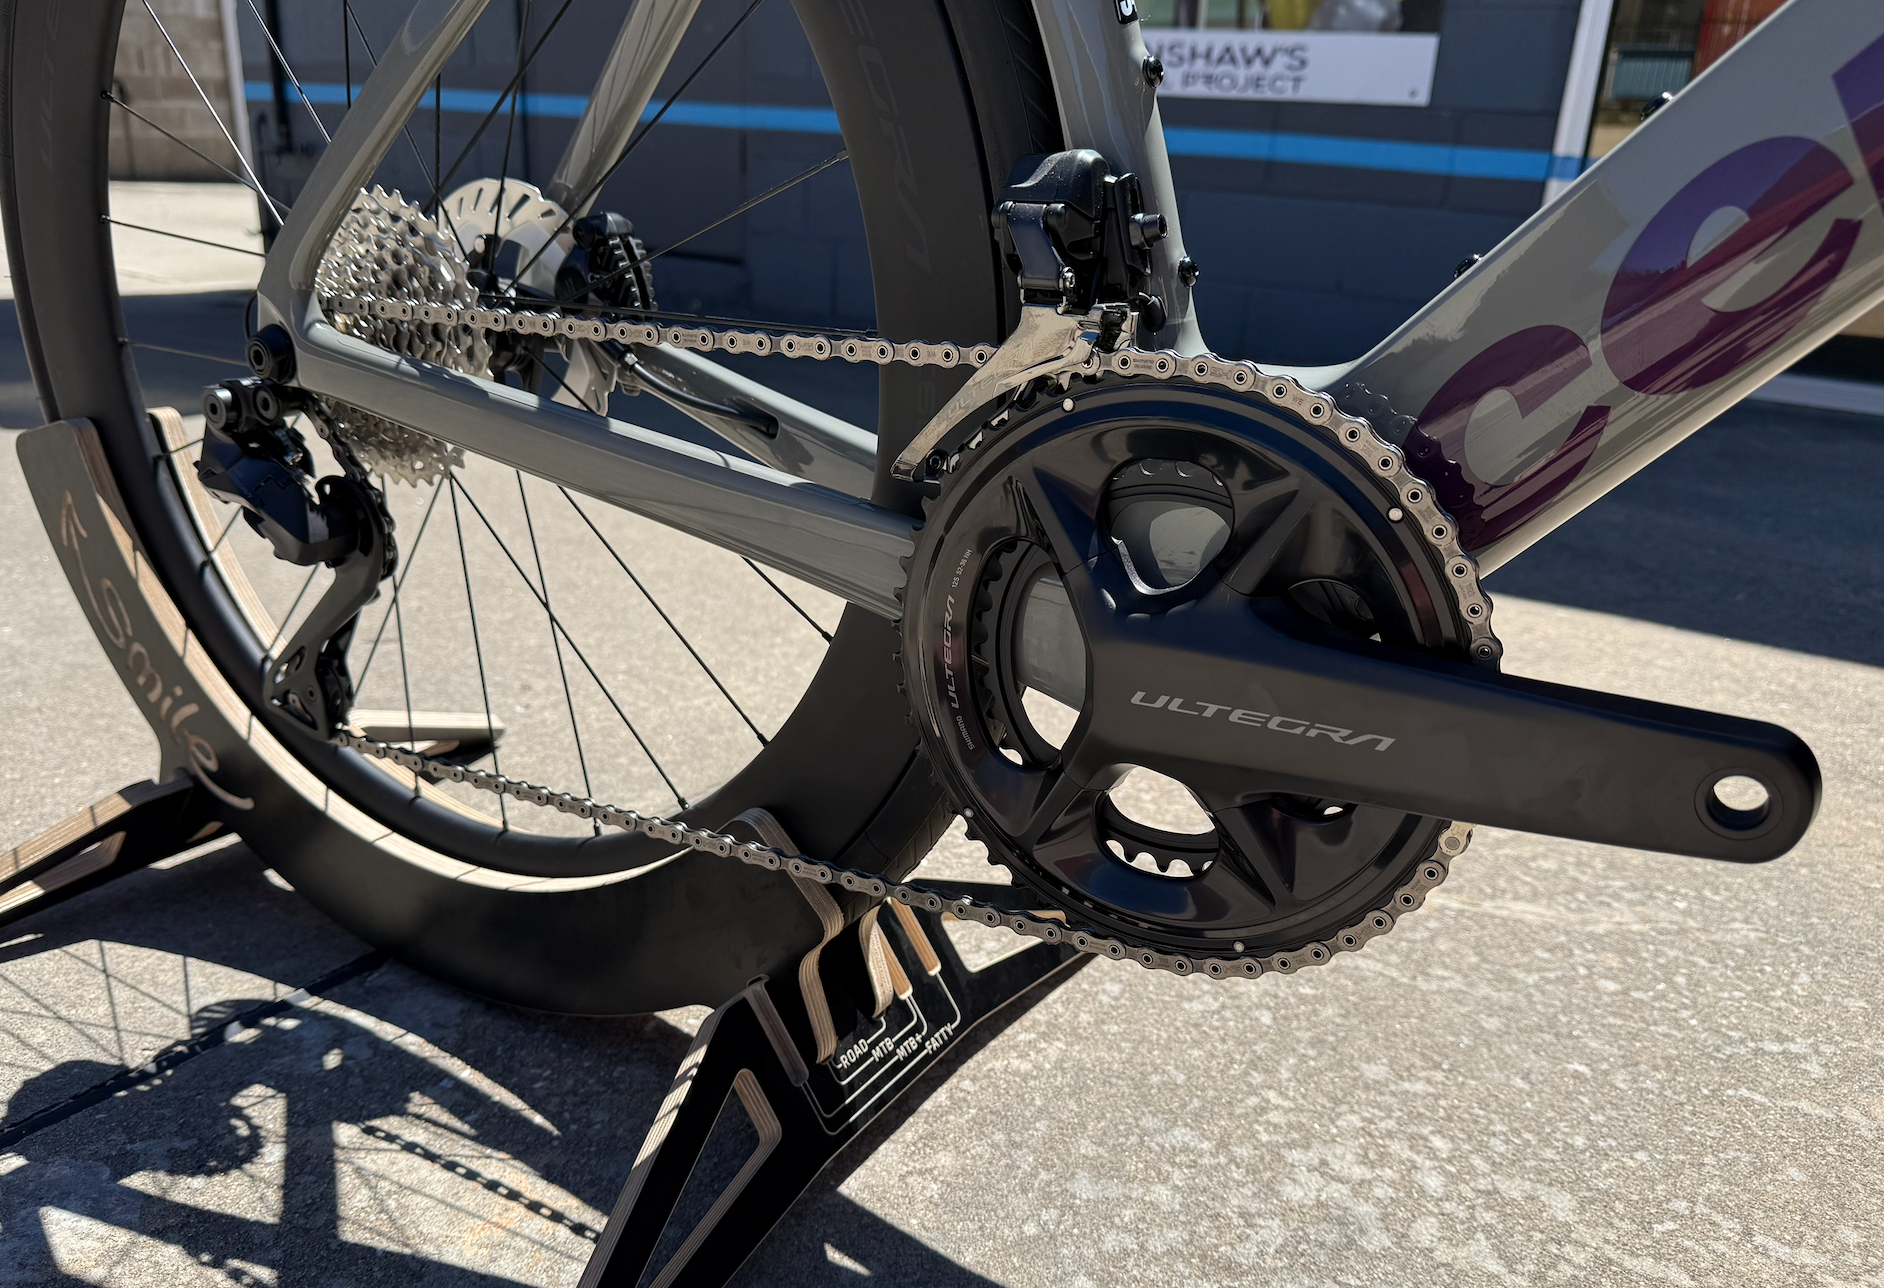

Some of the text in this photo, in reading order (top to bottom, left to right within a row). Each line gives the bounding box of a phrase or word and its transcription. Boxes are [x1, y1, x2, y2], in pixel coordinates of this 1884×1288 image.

[1182, 70, 1304, 95] PROJECT
[951, 576, 960, 588] 12S
[943, 594, 960, 709] ULTEGRA
[956, 715, 976, 751] SHIMANO
[1130, 691, 1396, 751] ULTEGRA
[839, 1037, 869, 1070] ROAD
[871, 1036, 895, 1062] MTB
[895, 1032, 923, 1061] MTB+
[925, 1022, 954, 1055] FATTY
